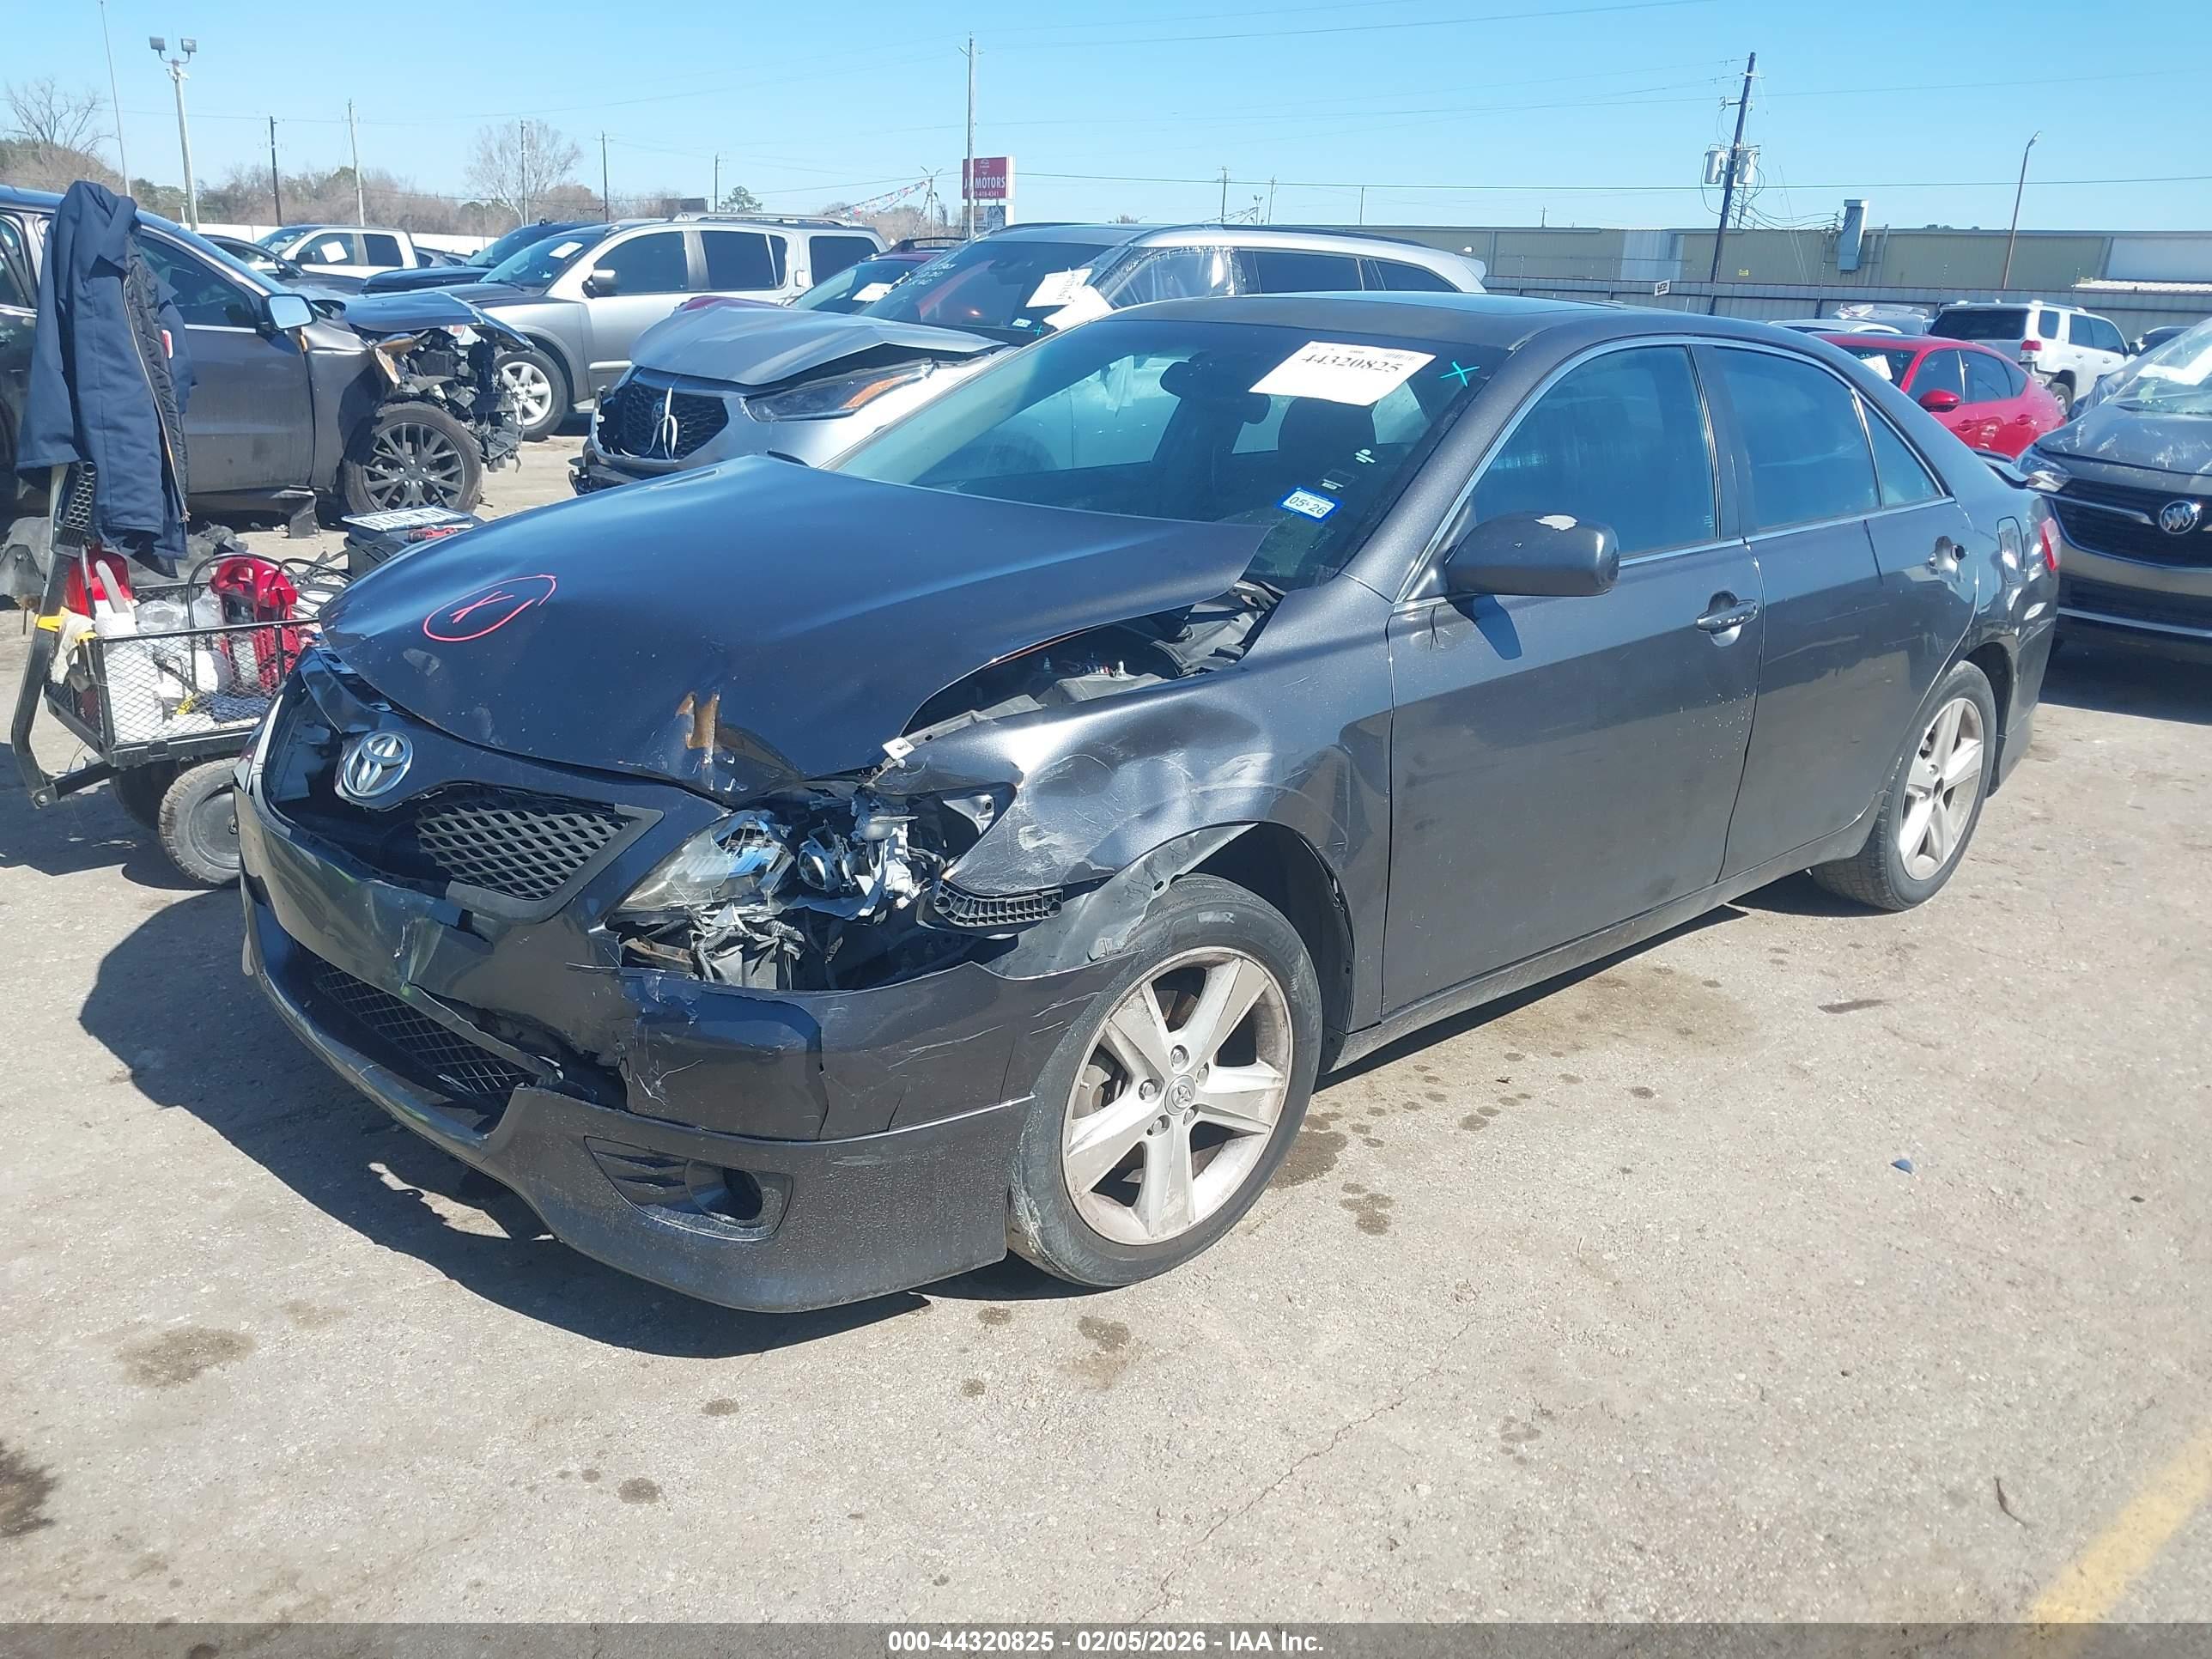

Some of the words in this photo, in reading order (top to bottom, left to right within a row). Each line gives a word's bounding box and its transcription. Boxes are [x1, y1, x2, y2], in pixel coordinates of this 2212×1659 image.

[975, 177, 1006, 189] MOTORS
[1657, 283, 1668, 294] 15
[1301, 353, 1404, 373] 44320825
[1288, 495, 1306, 507] 05
[1309, 502, 1328, 515] 26
